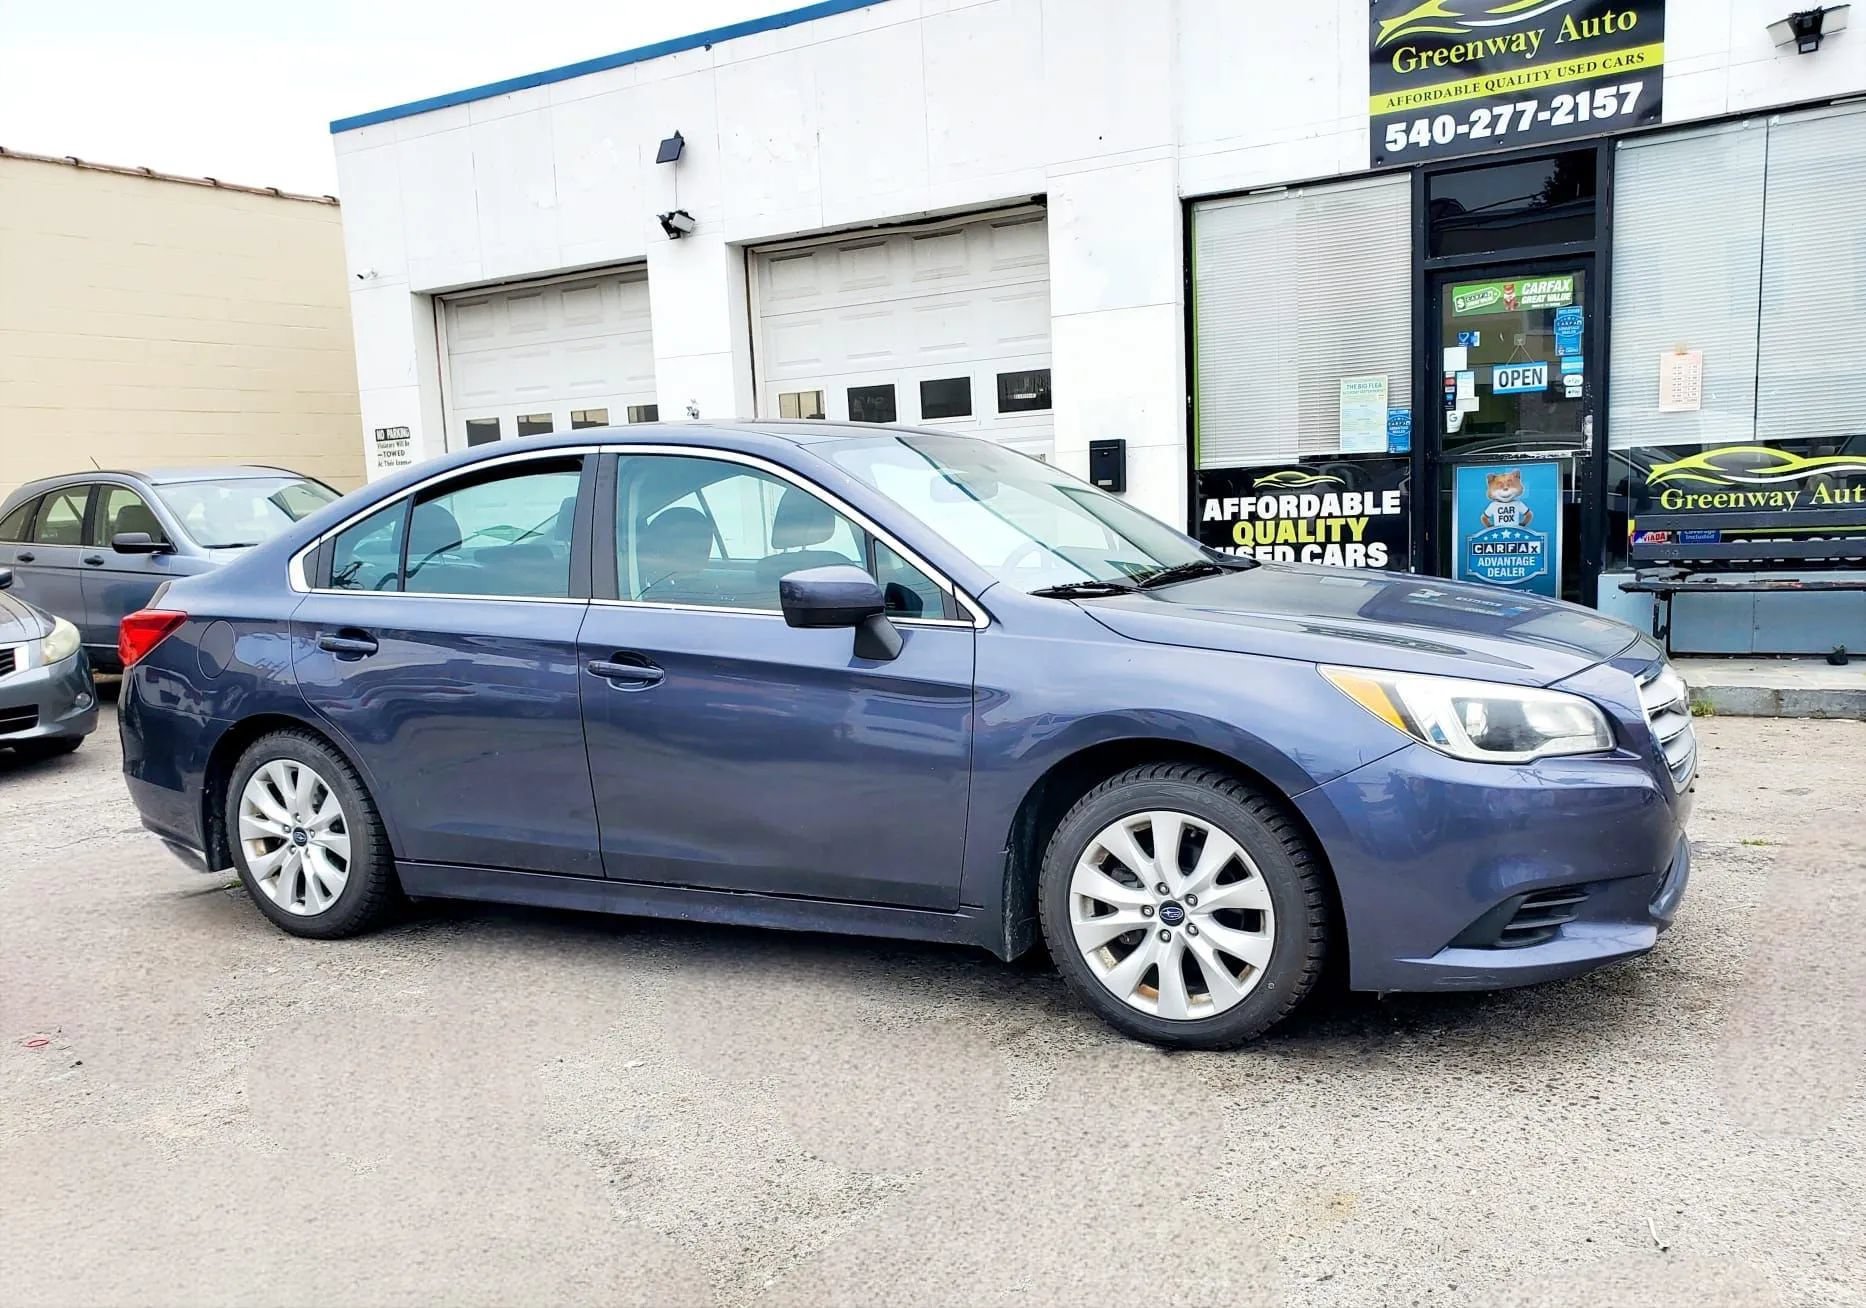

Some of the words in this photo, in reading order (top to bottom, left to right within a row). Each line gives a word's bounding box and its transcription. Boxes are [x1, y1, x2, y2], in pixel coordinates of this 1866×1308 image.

[1391, 28, 1546, 74] Greenway
[1555, 9, 1638, 44] Auto
[1386, 82, 1481, 108] AFFORDABLE
[1485, 69, 1552, 92] QUALITY
[1557, 61, 1598, 79] USED
[1602, 52, 1645, 69] CARS
[1384, 81, 1644, 152] 540-277-2157
[1521, 279, 1572, 295] CARFAX
[1499, 367, 1543, 388] OPEN
[377, 429, 384, 440] NO
[386, 427, 410, 440] PARKING
[1203, 490, 1401, 521] AFFORDABLE
[1497, 506, 1516, 515] CAR
[1660, 488, 1801, 512] Greenway
[1498, 515, 1516, 523] FOX
[1232, 517, 1370, 547] QUALITY
[1300, 542, 1389, 568] CARS
[1473, 543, 1540, 554] CARFAX
[1477, 556, 1536, 567] ADVANTAGE
[1487, 567, 1525, 577] DEALER
